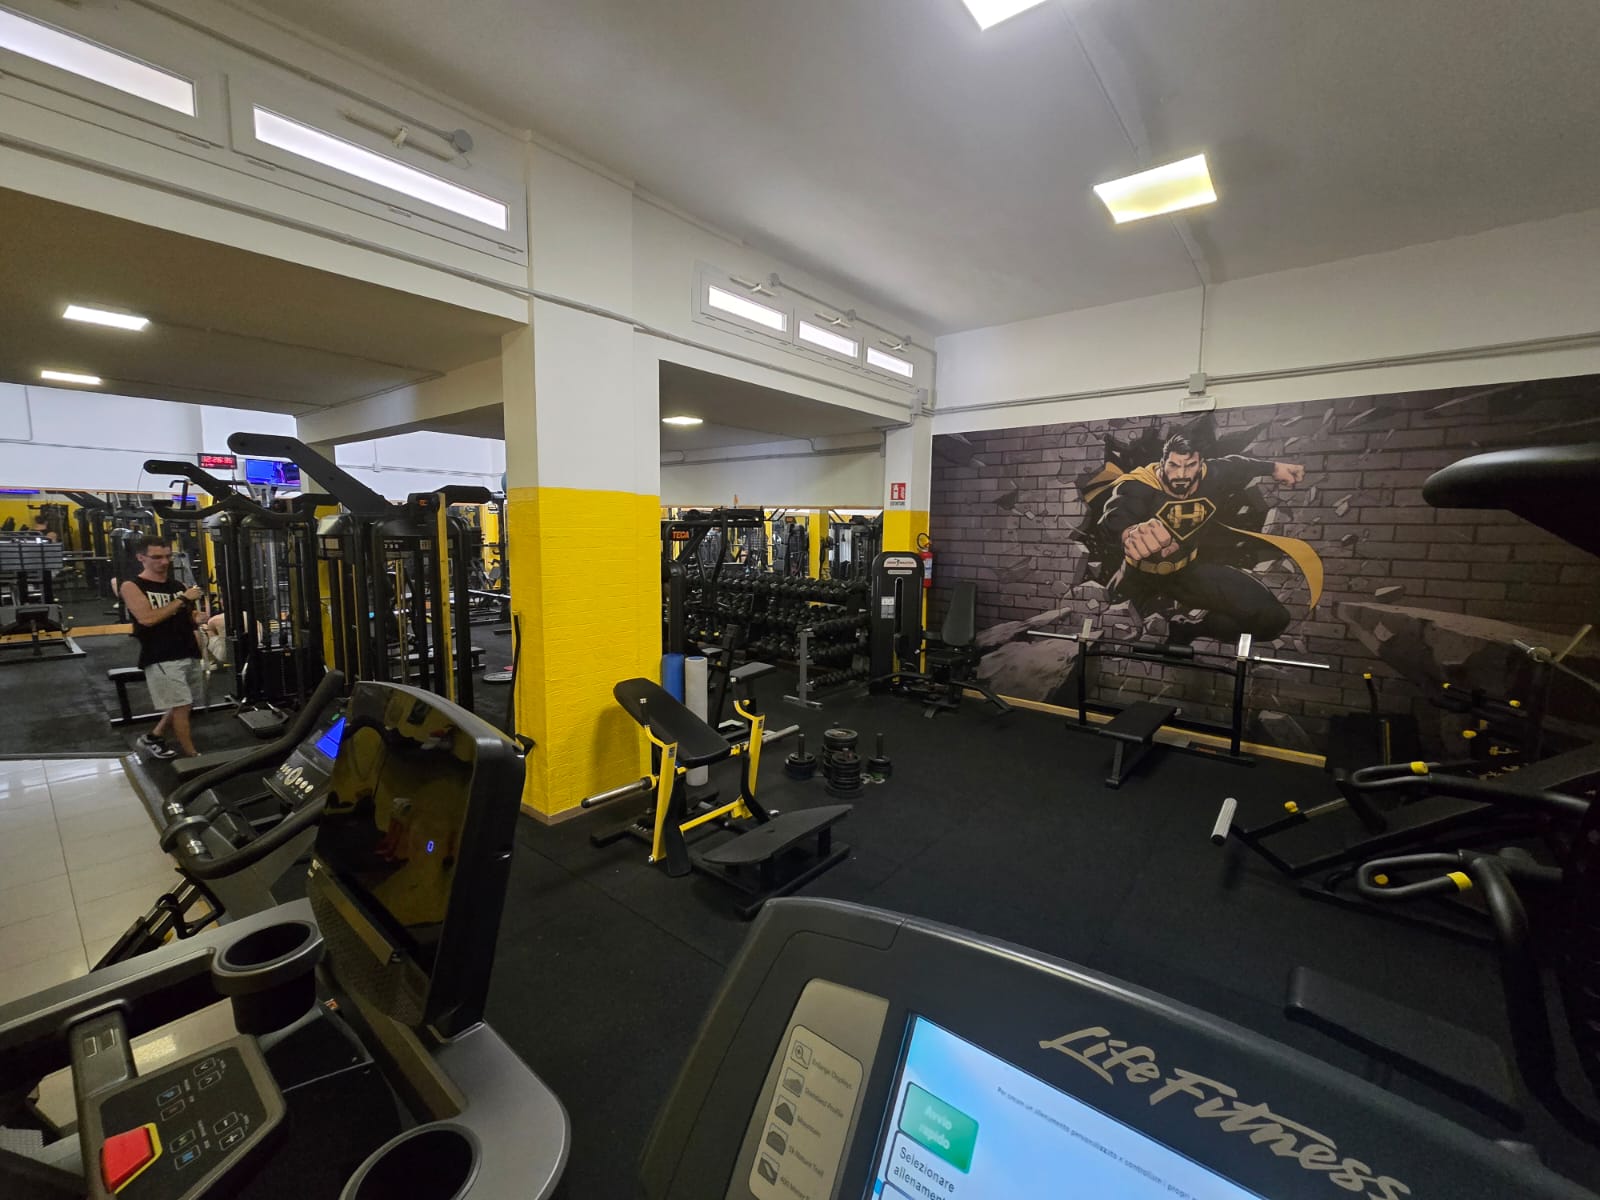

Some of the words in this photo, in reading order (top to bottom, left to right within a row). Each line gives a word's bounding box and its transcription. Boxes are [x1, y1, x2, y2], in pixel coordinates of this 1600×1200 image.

[924, 1105, 952, 1131] Avvio
[1039, 1026, 1160, 1085] Life
[1150, 1067, 1411, 1200] Fitness
[918, 1124, 950, 1150] rapido
[899, 1146, 955, 1193] Selezionare
